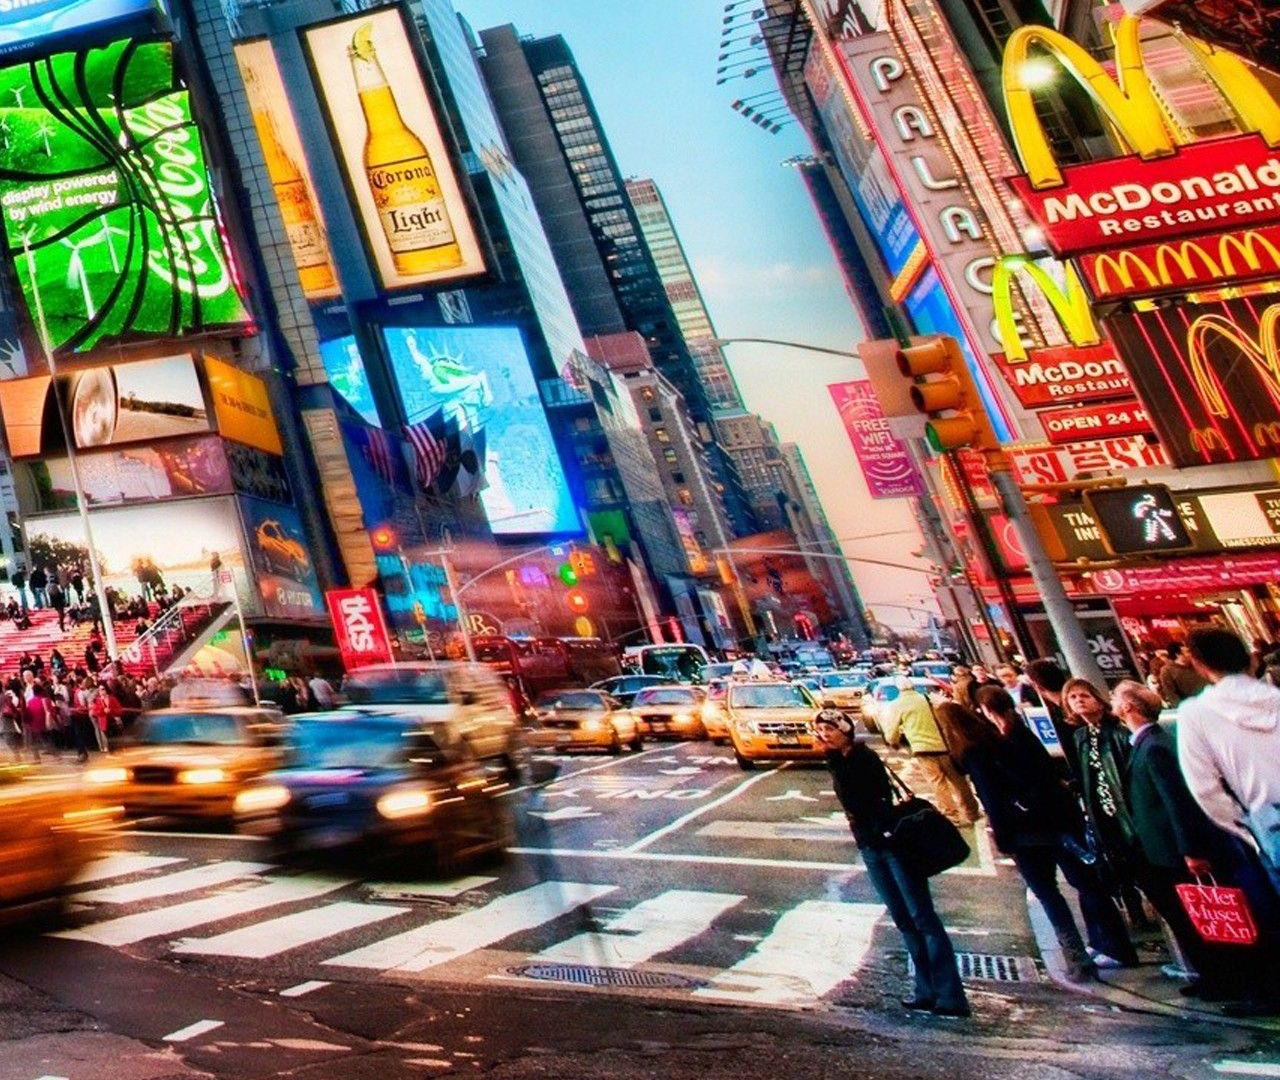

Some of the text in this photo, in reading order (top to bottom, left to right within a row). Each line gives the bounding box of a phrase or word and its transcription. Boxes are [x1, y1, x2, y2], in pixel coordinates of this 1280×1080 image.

[2, 171, 118, 206] display powered
[372, 165, 434, 189] Corona
[1043, 158, 1280, 224] McDonald
[9, 188, 117, 221] by wind energy
[1015, 359, 1126, 386] McDon
[1049, 377, 1131, 396] Restaur
[852, 420, 890, 433] FREE
[1048, 415, 1102, 432] OPEN
[1105, 411, 1131, 425] 24
[340, 595, 375, 652] tkts
[1200, 920, 1218, 937] of
